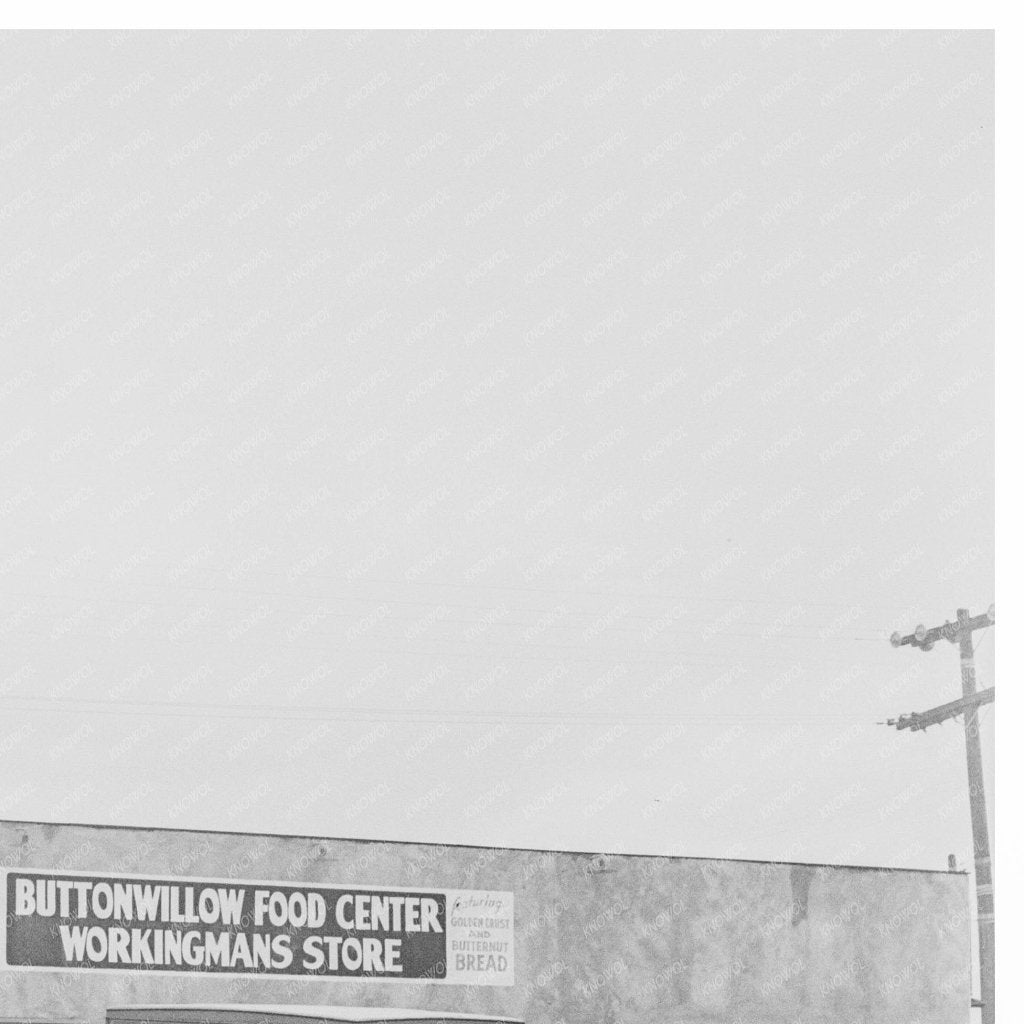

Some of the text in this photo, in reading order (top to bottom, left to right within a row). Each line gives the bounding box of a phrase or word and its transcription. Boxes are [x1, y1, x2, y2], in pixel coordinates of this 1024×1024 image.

[15, 877, 444, 933] BUTTONWILLOW FOOD CENTER
[59, 925, 403, 972] WORKINGMANS STORE
[452, 940, 509, 953] BUTTERNUT
[456, 953, 508, 972] BREAD
